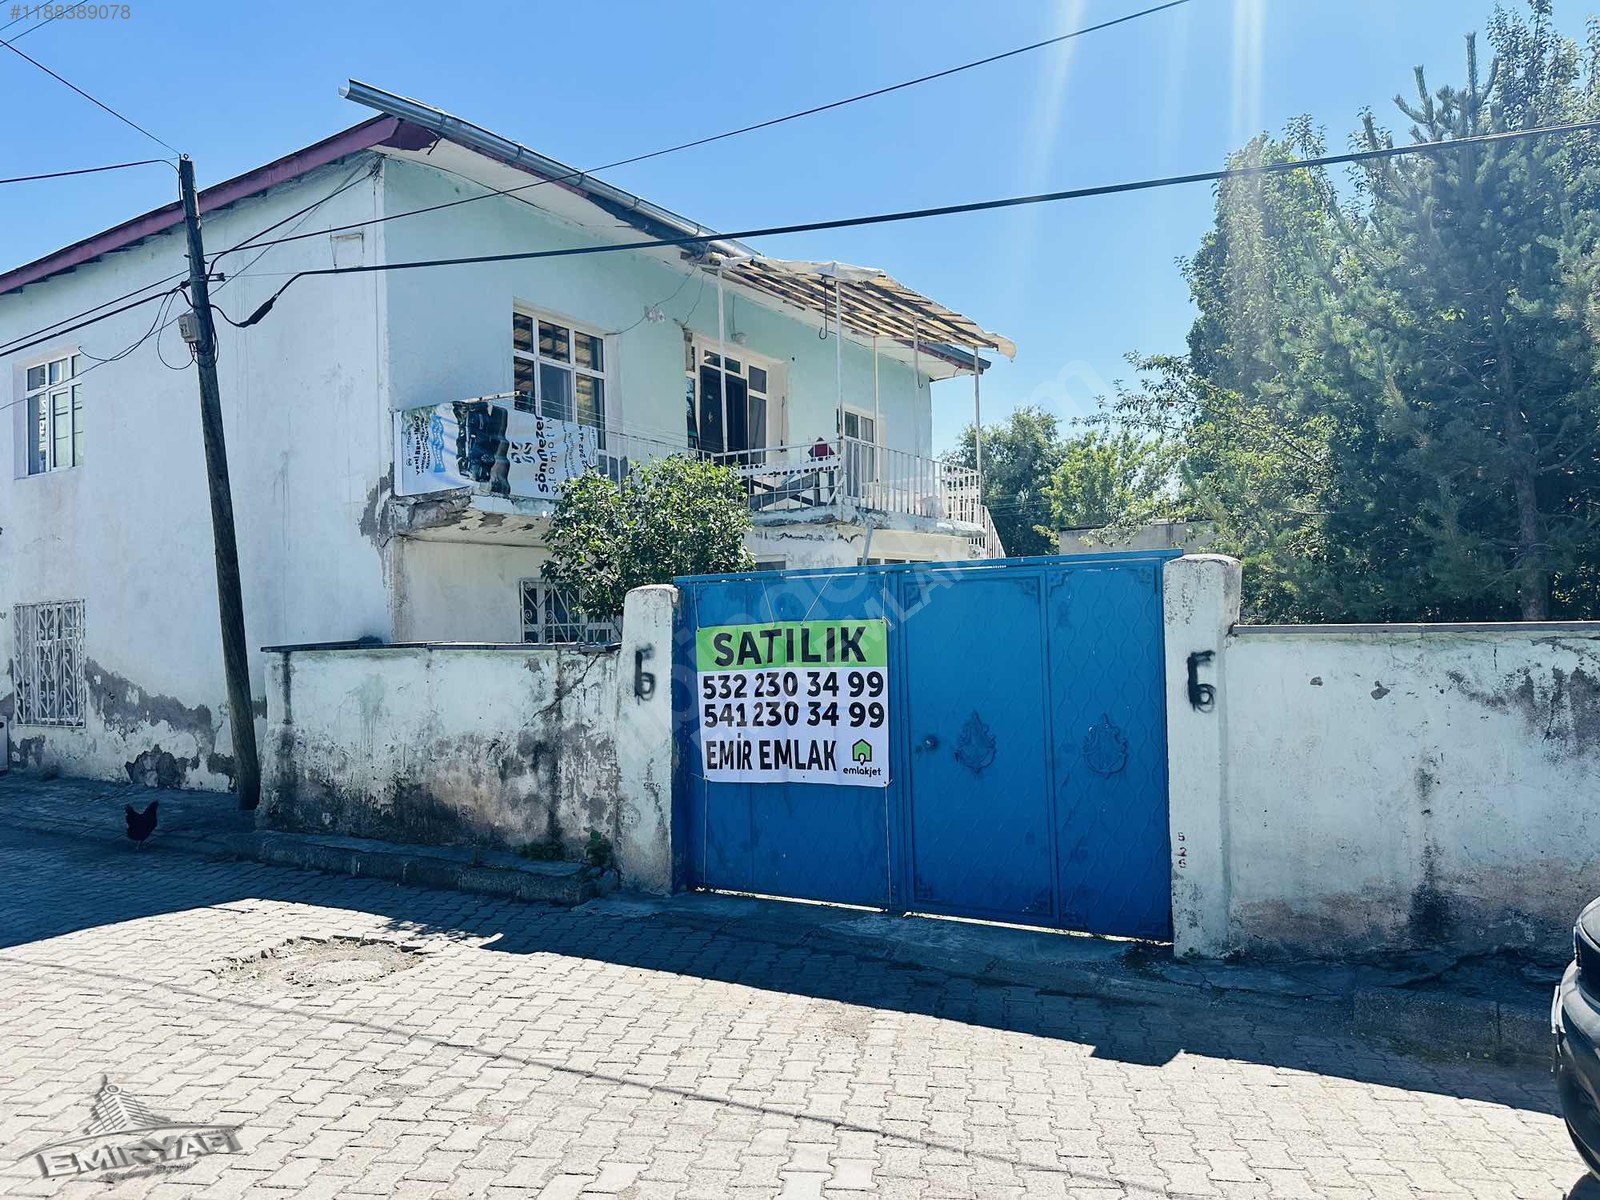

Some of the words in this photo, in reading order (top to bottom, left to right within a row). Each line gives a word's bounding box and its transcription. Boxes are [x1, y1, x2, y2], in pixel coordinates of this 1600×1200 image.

[535, 414, 549, 493] sönmezer
[714, 626, 867, 666] SATILIK
[703, 674, 748, 699] 532
[754, 672, 799, 698] 230
[806, 671, 839, 697] 34
[847, 671, 884, 698] 99
[704, 703, 748, 728] 541
[752, 702, 799, 727] 230
[806, 702, 839, 727] 34
[848, 702, 885, 728] 99
[706, 732, 752, 770] EMİR
[759, 739, 837, 771] EMLAK
[843, 766, 881, 777] emlakjet
